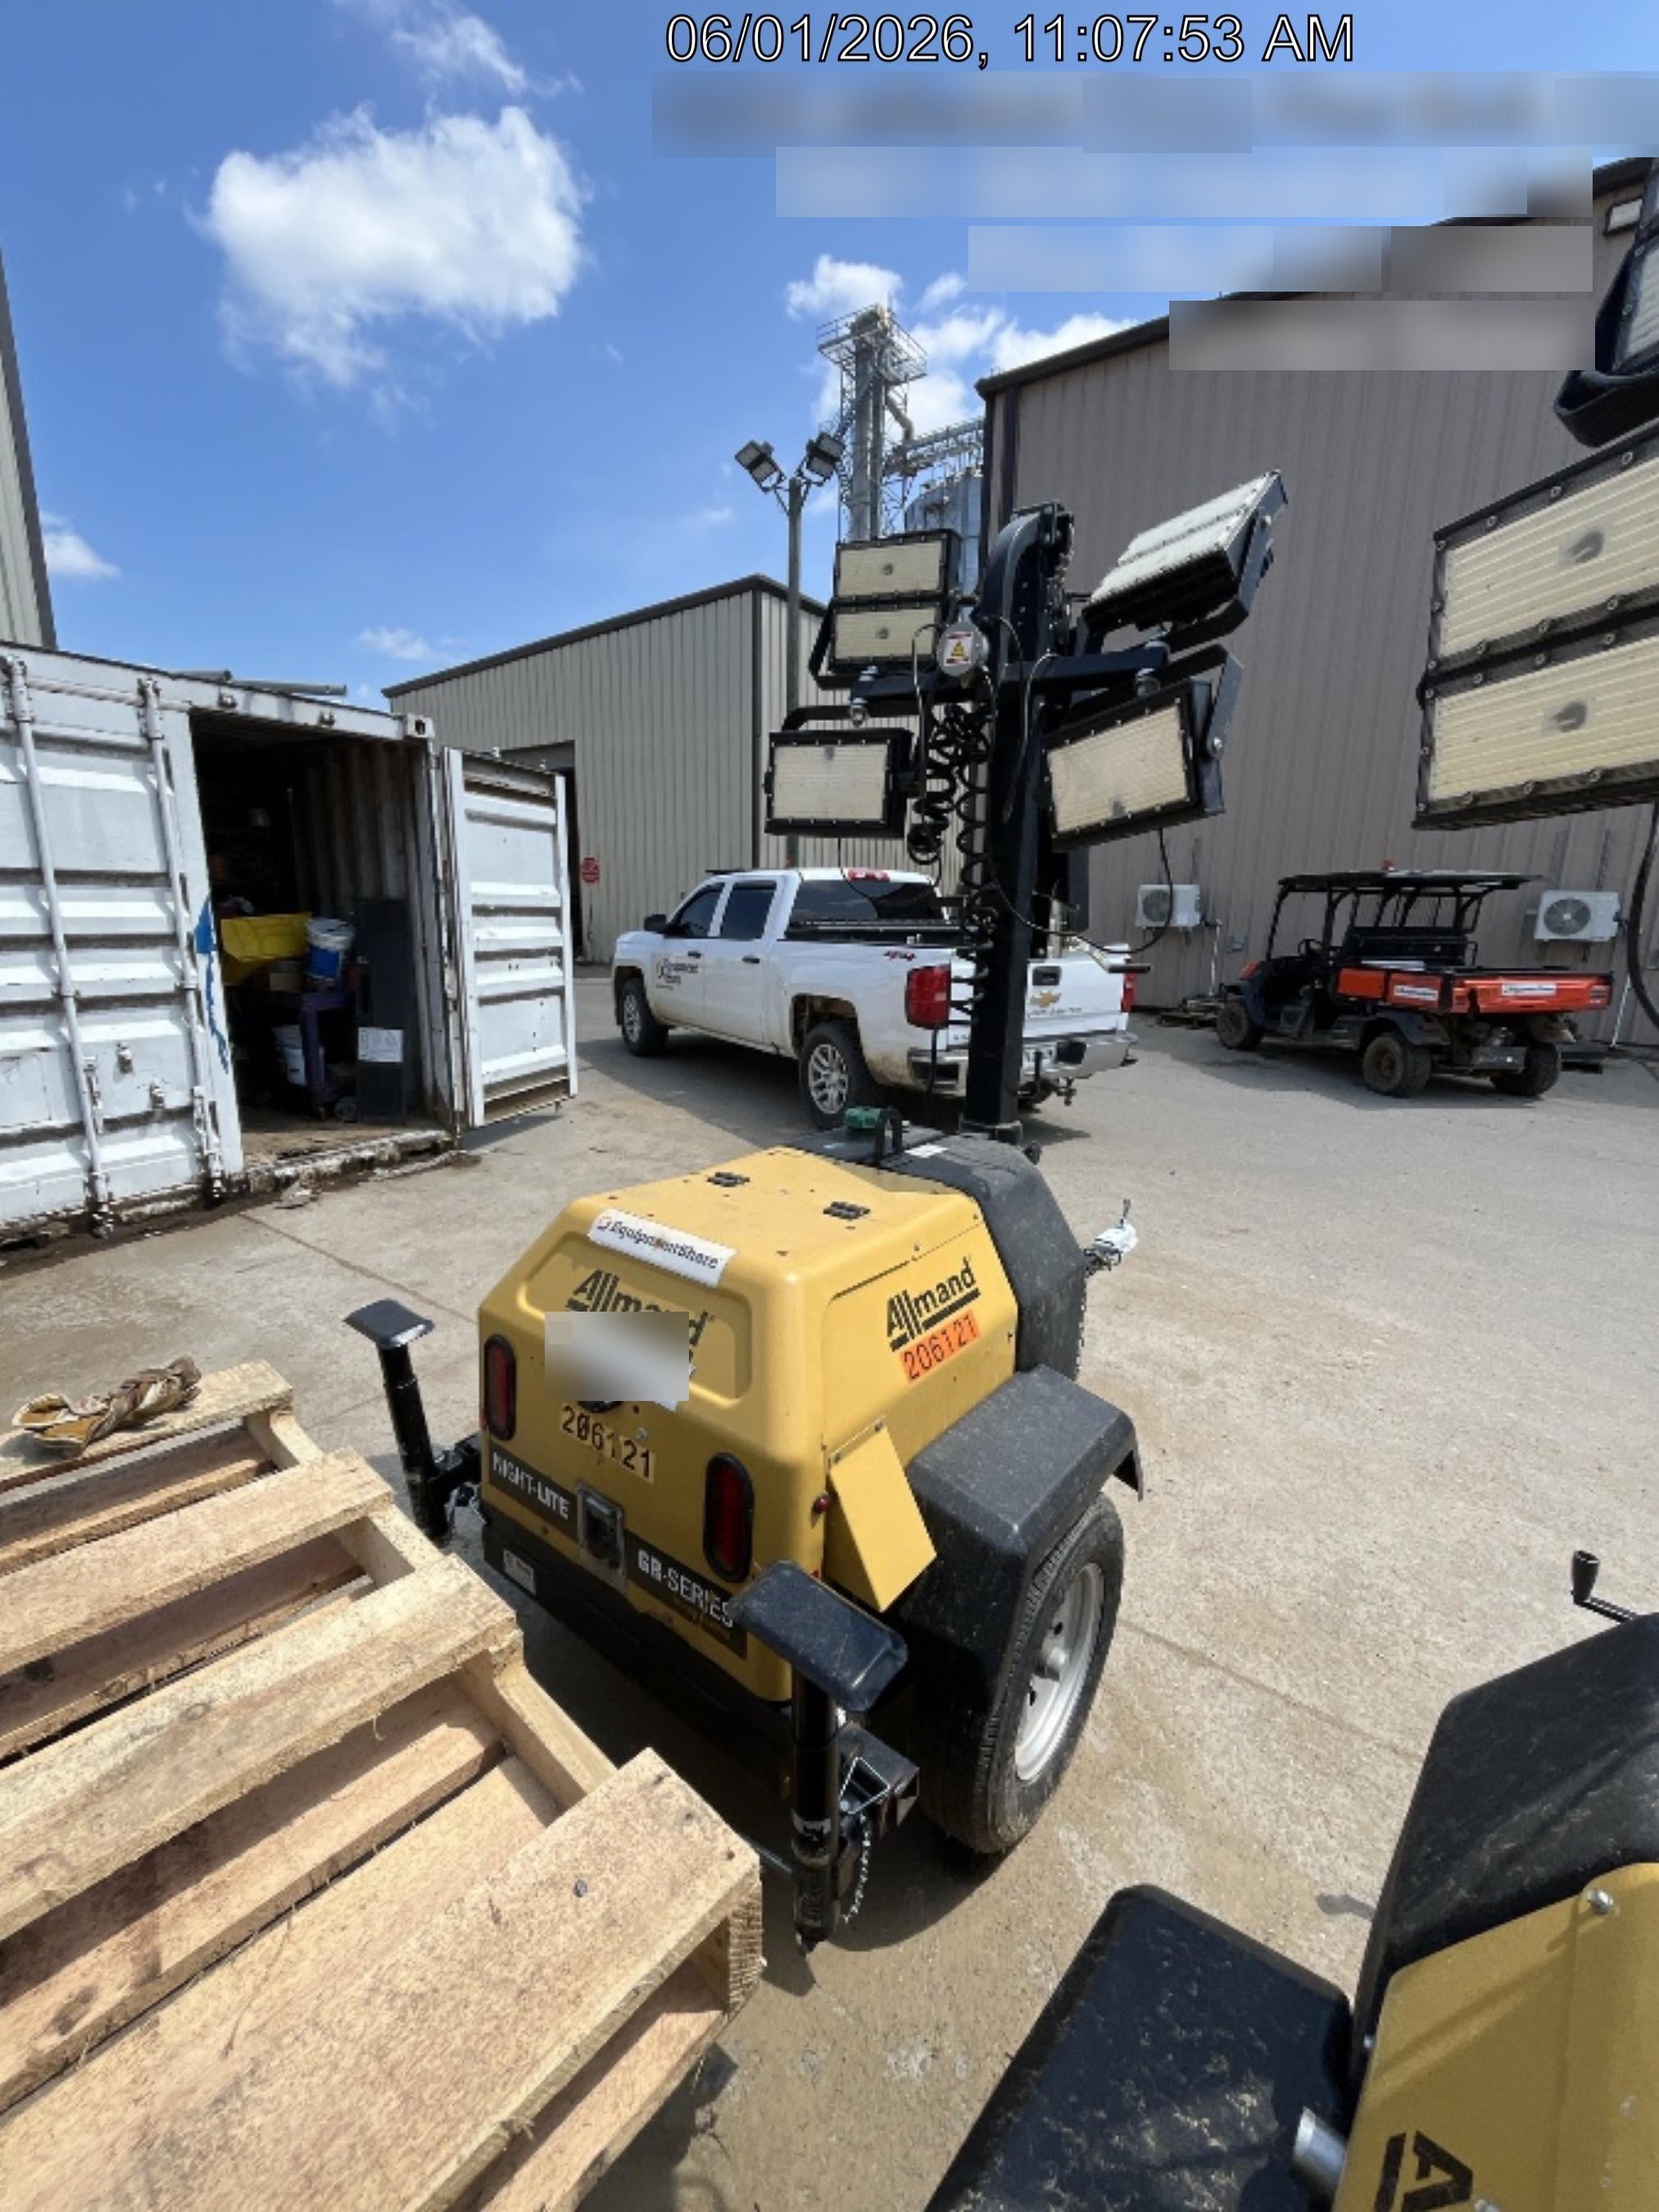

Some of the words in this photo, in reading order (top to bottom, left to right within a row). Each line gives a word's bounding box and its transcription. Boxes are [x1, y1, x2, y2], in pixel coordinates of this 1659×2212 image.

[573, 1269, 709, 1348] Allmd
[887, 1255, 977, 1340] Allmand
[904, 1313, 977, 1380] 206121
[561, 1404, 650, 1478] 206121
[492, 1451, 572, 1520] NIGHT-LITE
[637, 1548, 734, 1628] GR-SERIES
